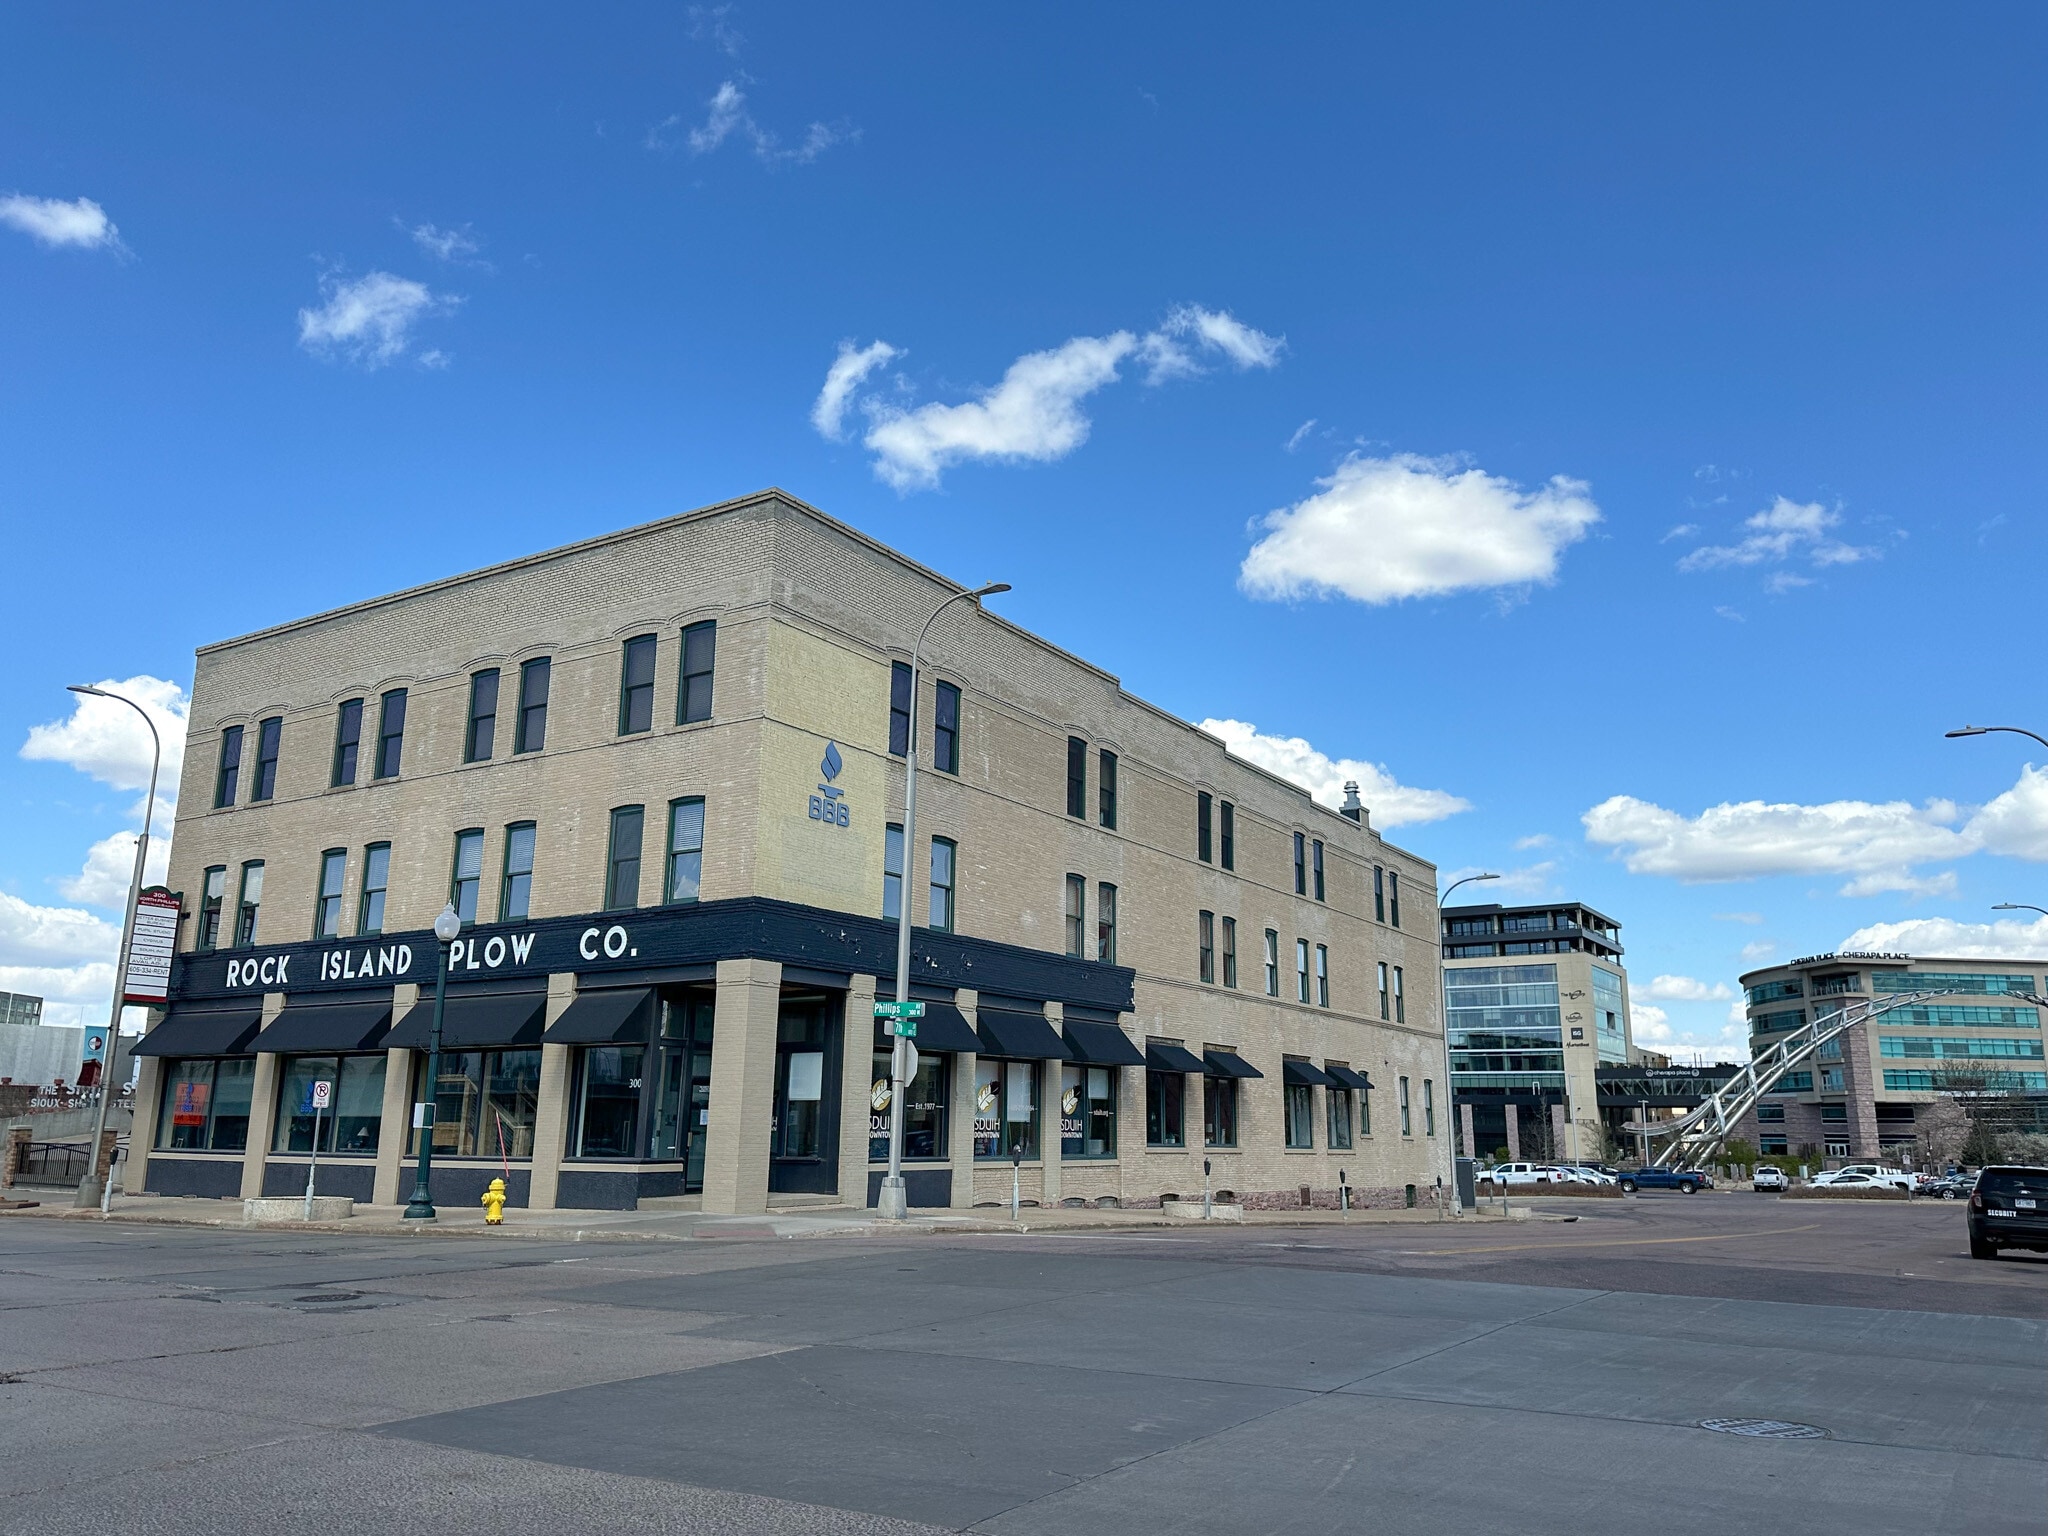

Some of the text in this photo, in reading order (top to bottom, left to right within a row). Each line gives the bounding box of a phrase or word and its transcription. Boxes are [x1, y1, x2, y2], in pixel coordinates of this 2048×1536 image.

[809, 795, 849, 827] BBB
[226, 925, 637, 987] ROCK ISLAND PLOW CO.
[1843, 951, 1909, 960] CHERAPA PLACE
[874, 1003, 901, 1016] Phillips
[629, 1079, 642, 1088] 300
[40, 1086, 59, 1095] THE
[974, 1118, 1000, 1130] SDUIH
[974, 1131, 1000, 1139] DOWNTOWN
[1987, 1209, 2017, 1217] SECURITY
